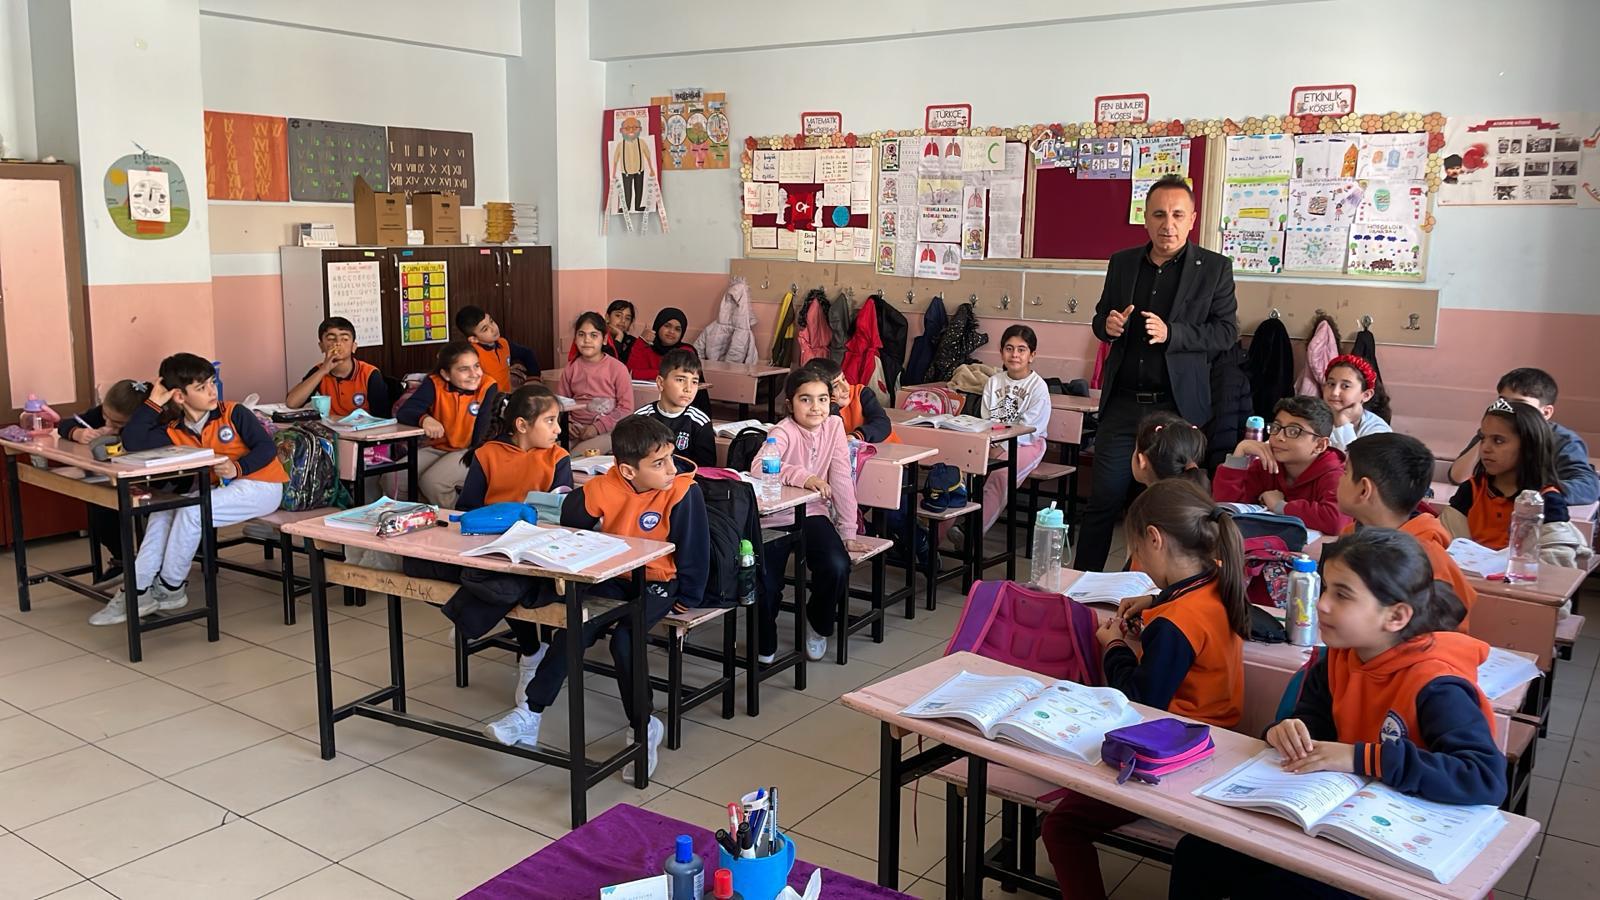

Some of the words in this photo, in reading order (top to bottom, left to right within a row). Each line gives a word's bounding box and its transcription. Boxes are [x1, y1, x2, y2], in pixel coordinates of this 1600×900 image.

[1304, 90, 1342, 102] ETKİNLİK
[1101, 102, 1114, 110] FEN
[1115, 101, 1144, 110] BİLİMLERİ
[1309, 103, 1334, 112] KÖŞESİ
[935, 109, 961, 118] TÜRKÇE
[806, 116, 837, 124] MATEMATİK
[390, 142, 394, 153] I
[404, 144, 410, 156] II
[430, 145, 438, 157] IV
[443, 148, 450, 156] V
[457, 149, 465, 158] VI
[390, 163, 402, 172] VII
[418, 164, 425, 173] IX
[430, 164, 437, 174] X
[441, 164, 450, 176] XI
[406, 176, 420, 185] XIV
[424, 177, 436, 186] XV
[424, 275, 429, 284] 2
[403, 290, 408, 299] 3
[424, 289, 429, 298] 4
[403, 304, 408, 313] 5
[425, 303, 430, 312] 6
[404, 317, 408, 328] 7
